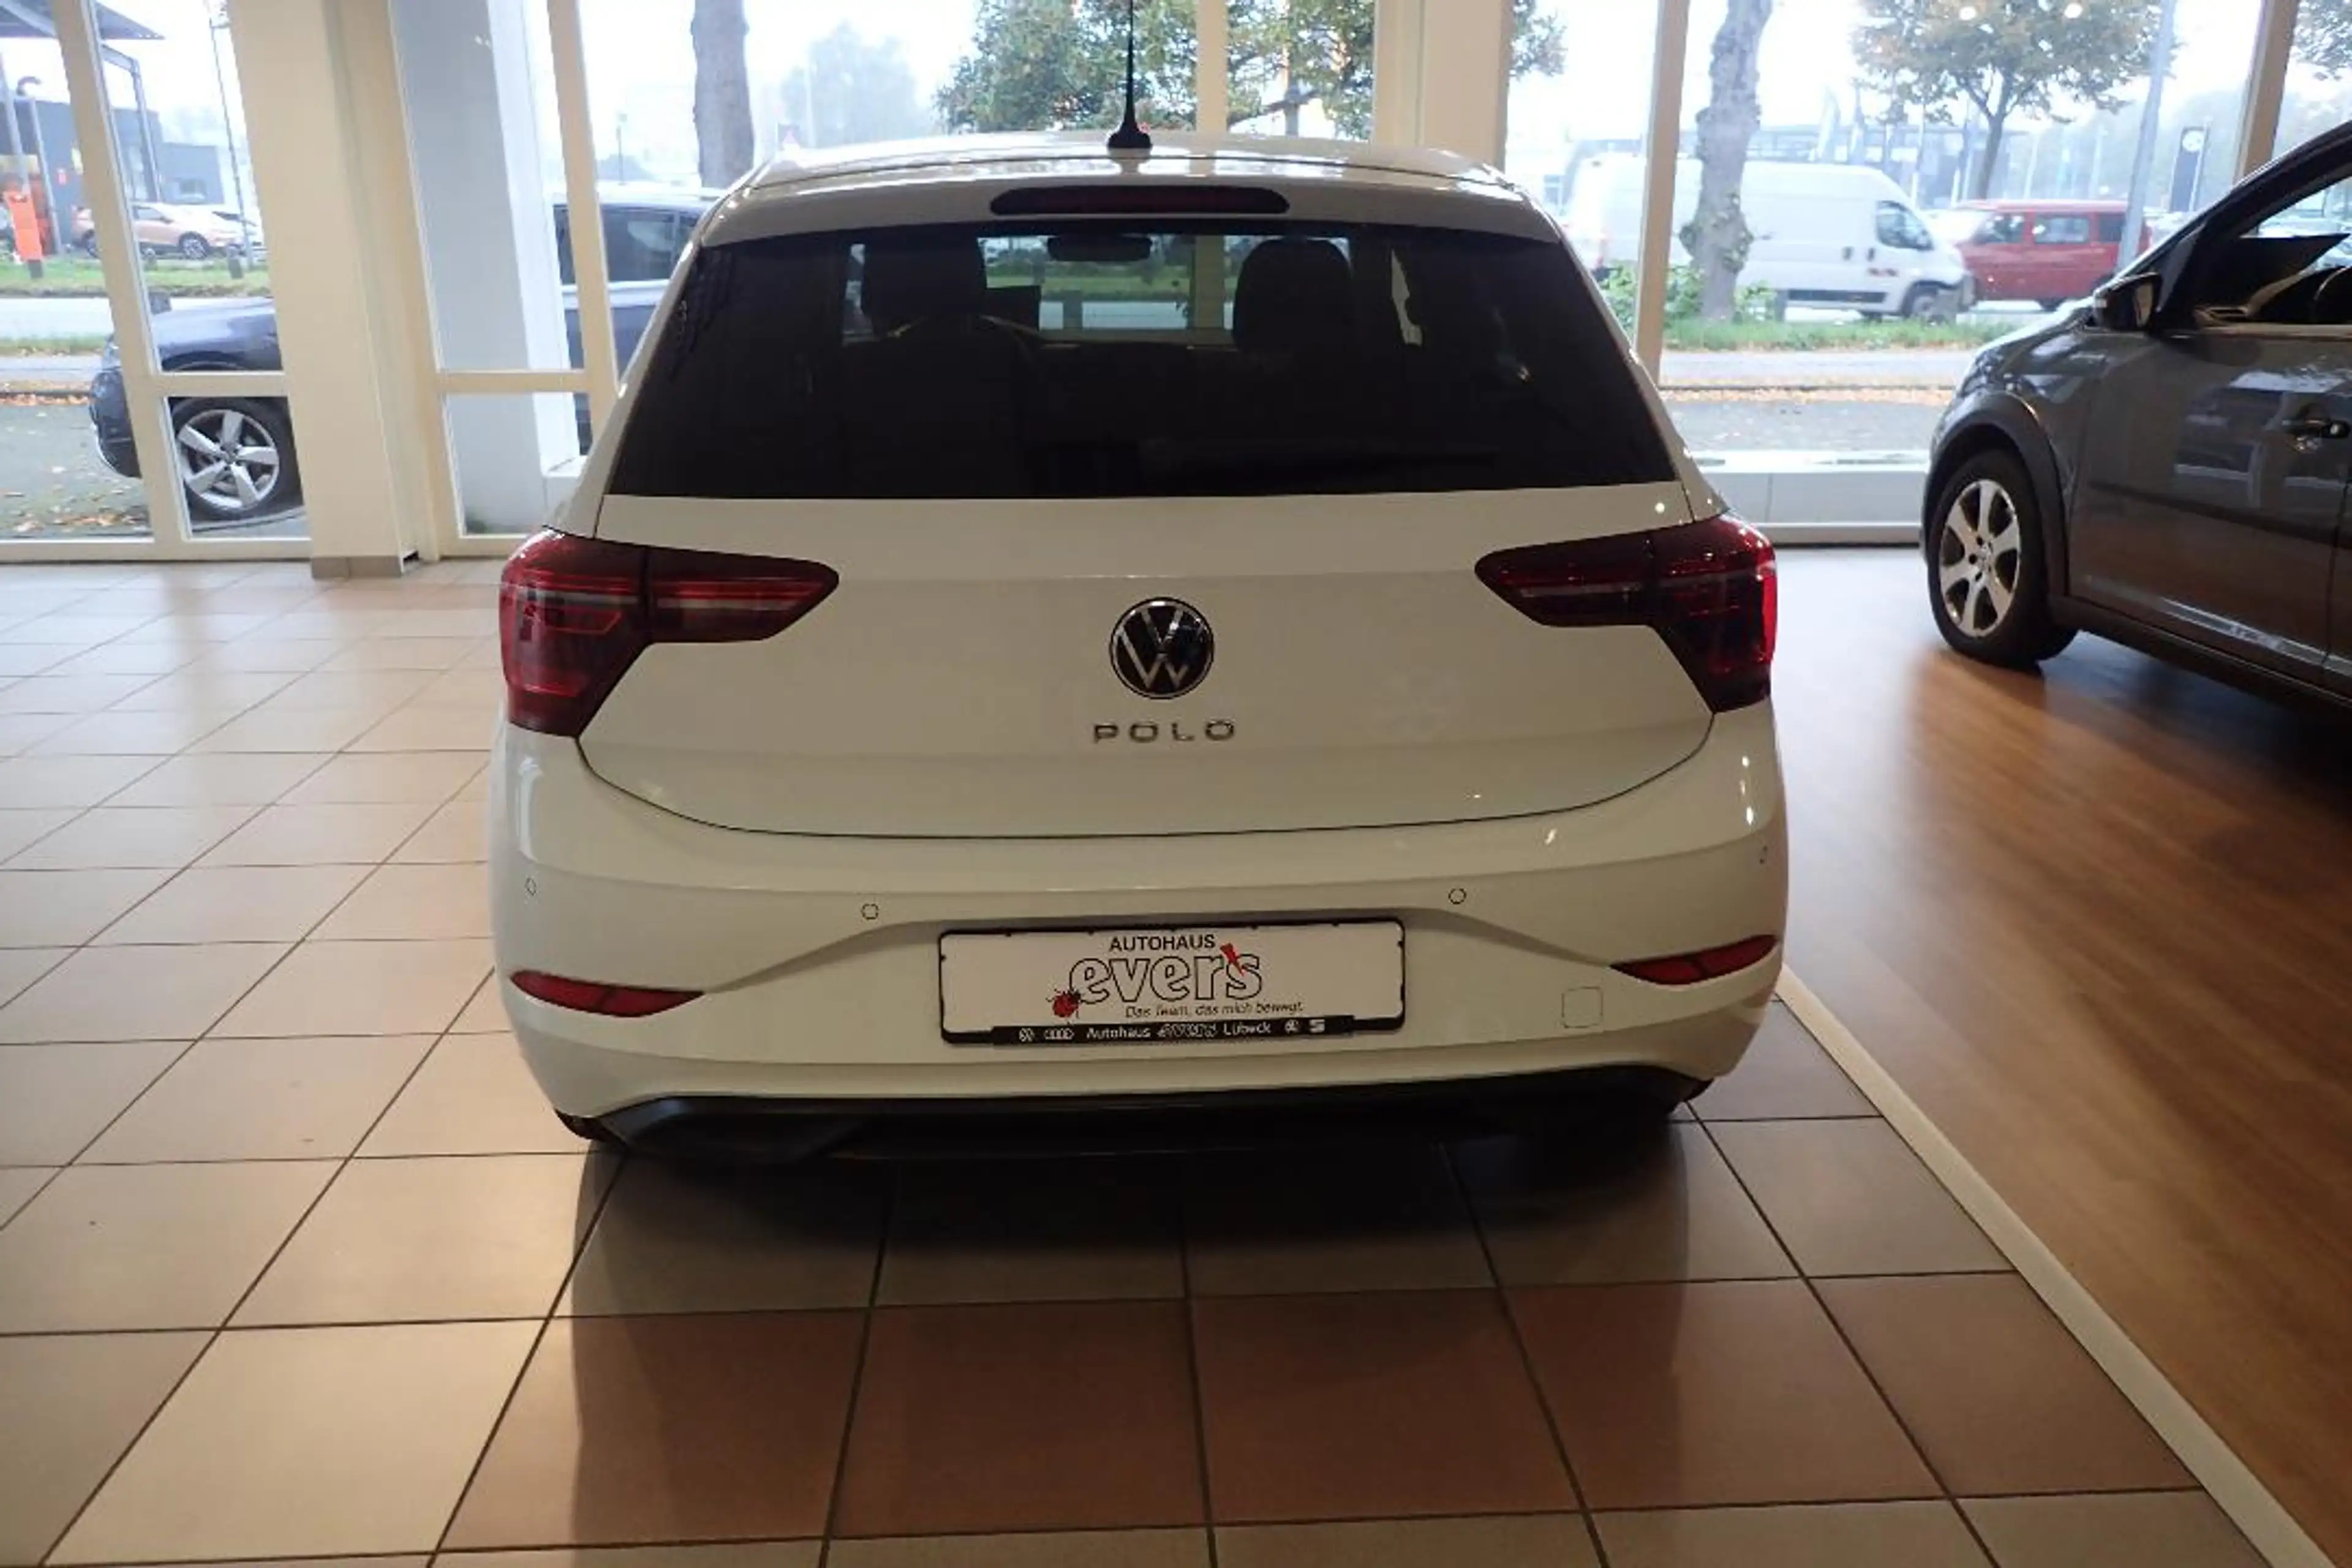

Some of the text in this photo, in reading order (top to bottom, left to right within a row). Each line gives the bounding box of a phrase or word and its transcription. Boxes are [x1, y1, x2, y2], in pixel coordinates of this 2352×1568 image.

[1093, 720, 1235, 744] POLO
[1108, 933, 1216, 952] AUTOHAUS
[1195, 1003, 1219, 1016] das
[1222, 1001, 1253, 1014] mich
[1086, 1025, 1151, 1040] Autohaus
